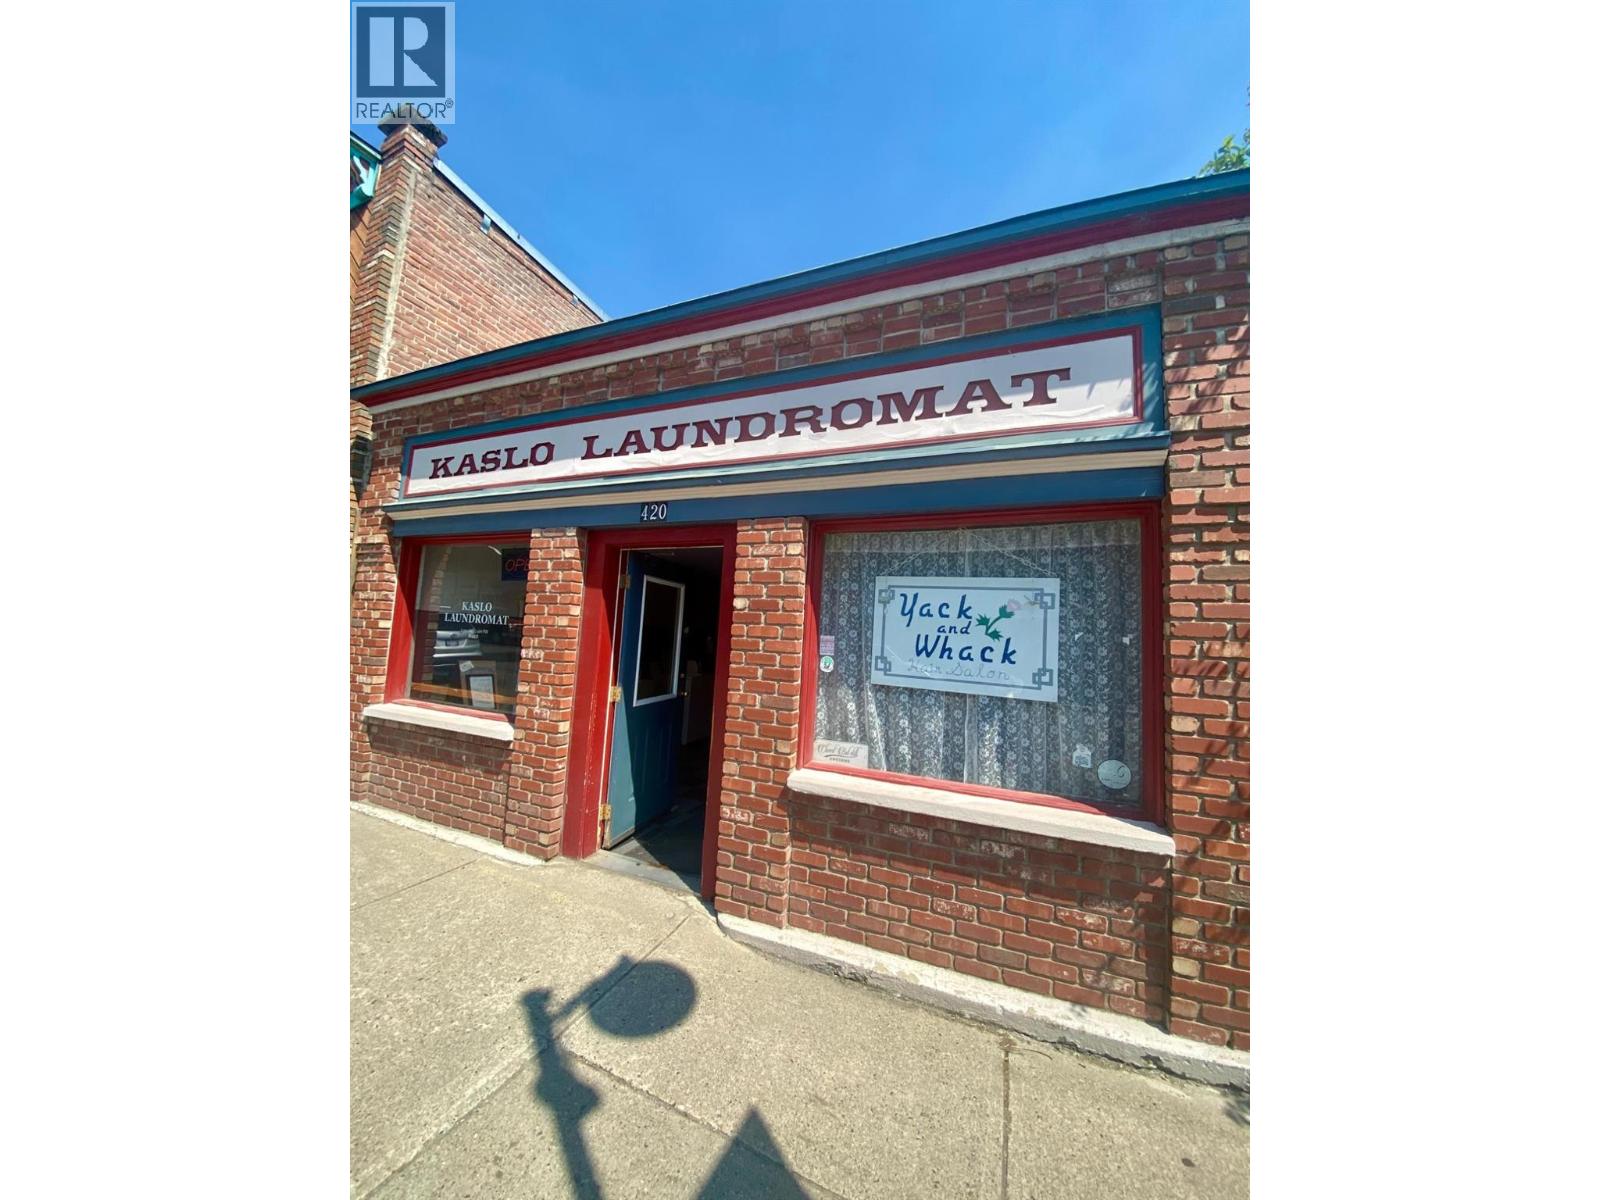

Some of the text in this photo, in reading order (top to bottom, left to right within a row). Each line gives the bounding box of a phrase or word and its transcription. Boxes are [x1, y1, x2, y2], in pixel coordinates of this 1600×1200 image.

[429, 367, 1071, 480] KASLO LAUNDROMAT
[641, 503, 667, 520] 420
[462, 601, 493, 612] KASLO
[900, 592, 973, 627] Yack
[444, 612, 510, 626] LAUNDROMAT
[937, 621, 972, 635] and
[915, 633, 1017, 665] Whack
[945, 660, 1010, 681] Salon
